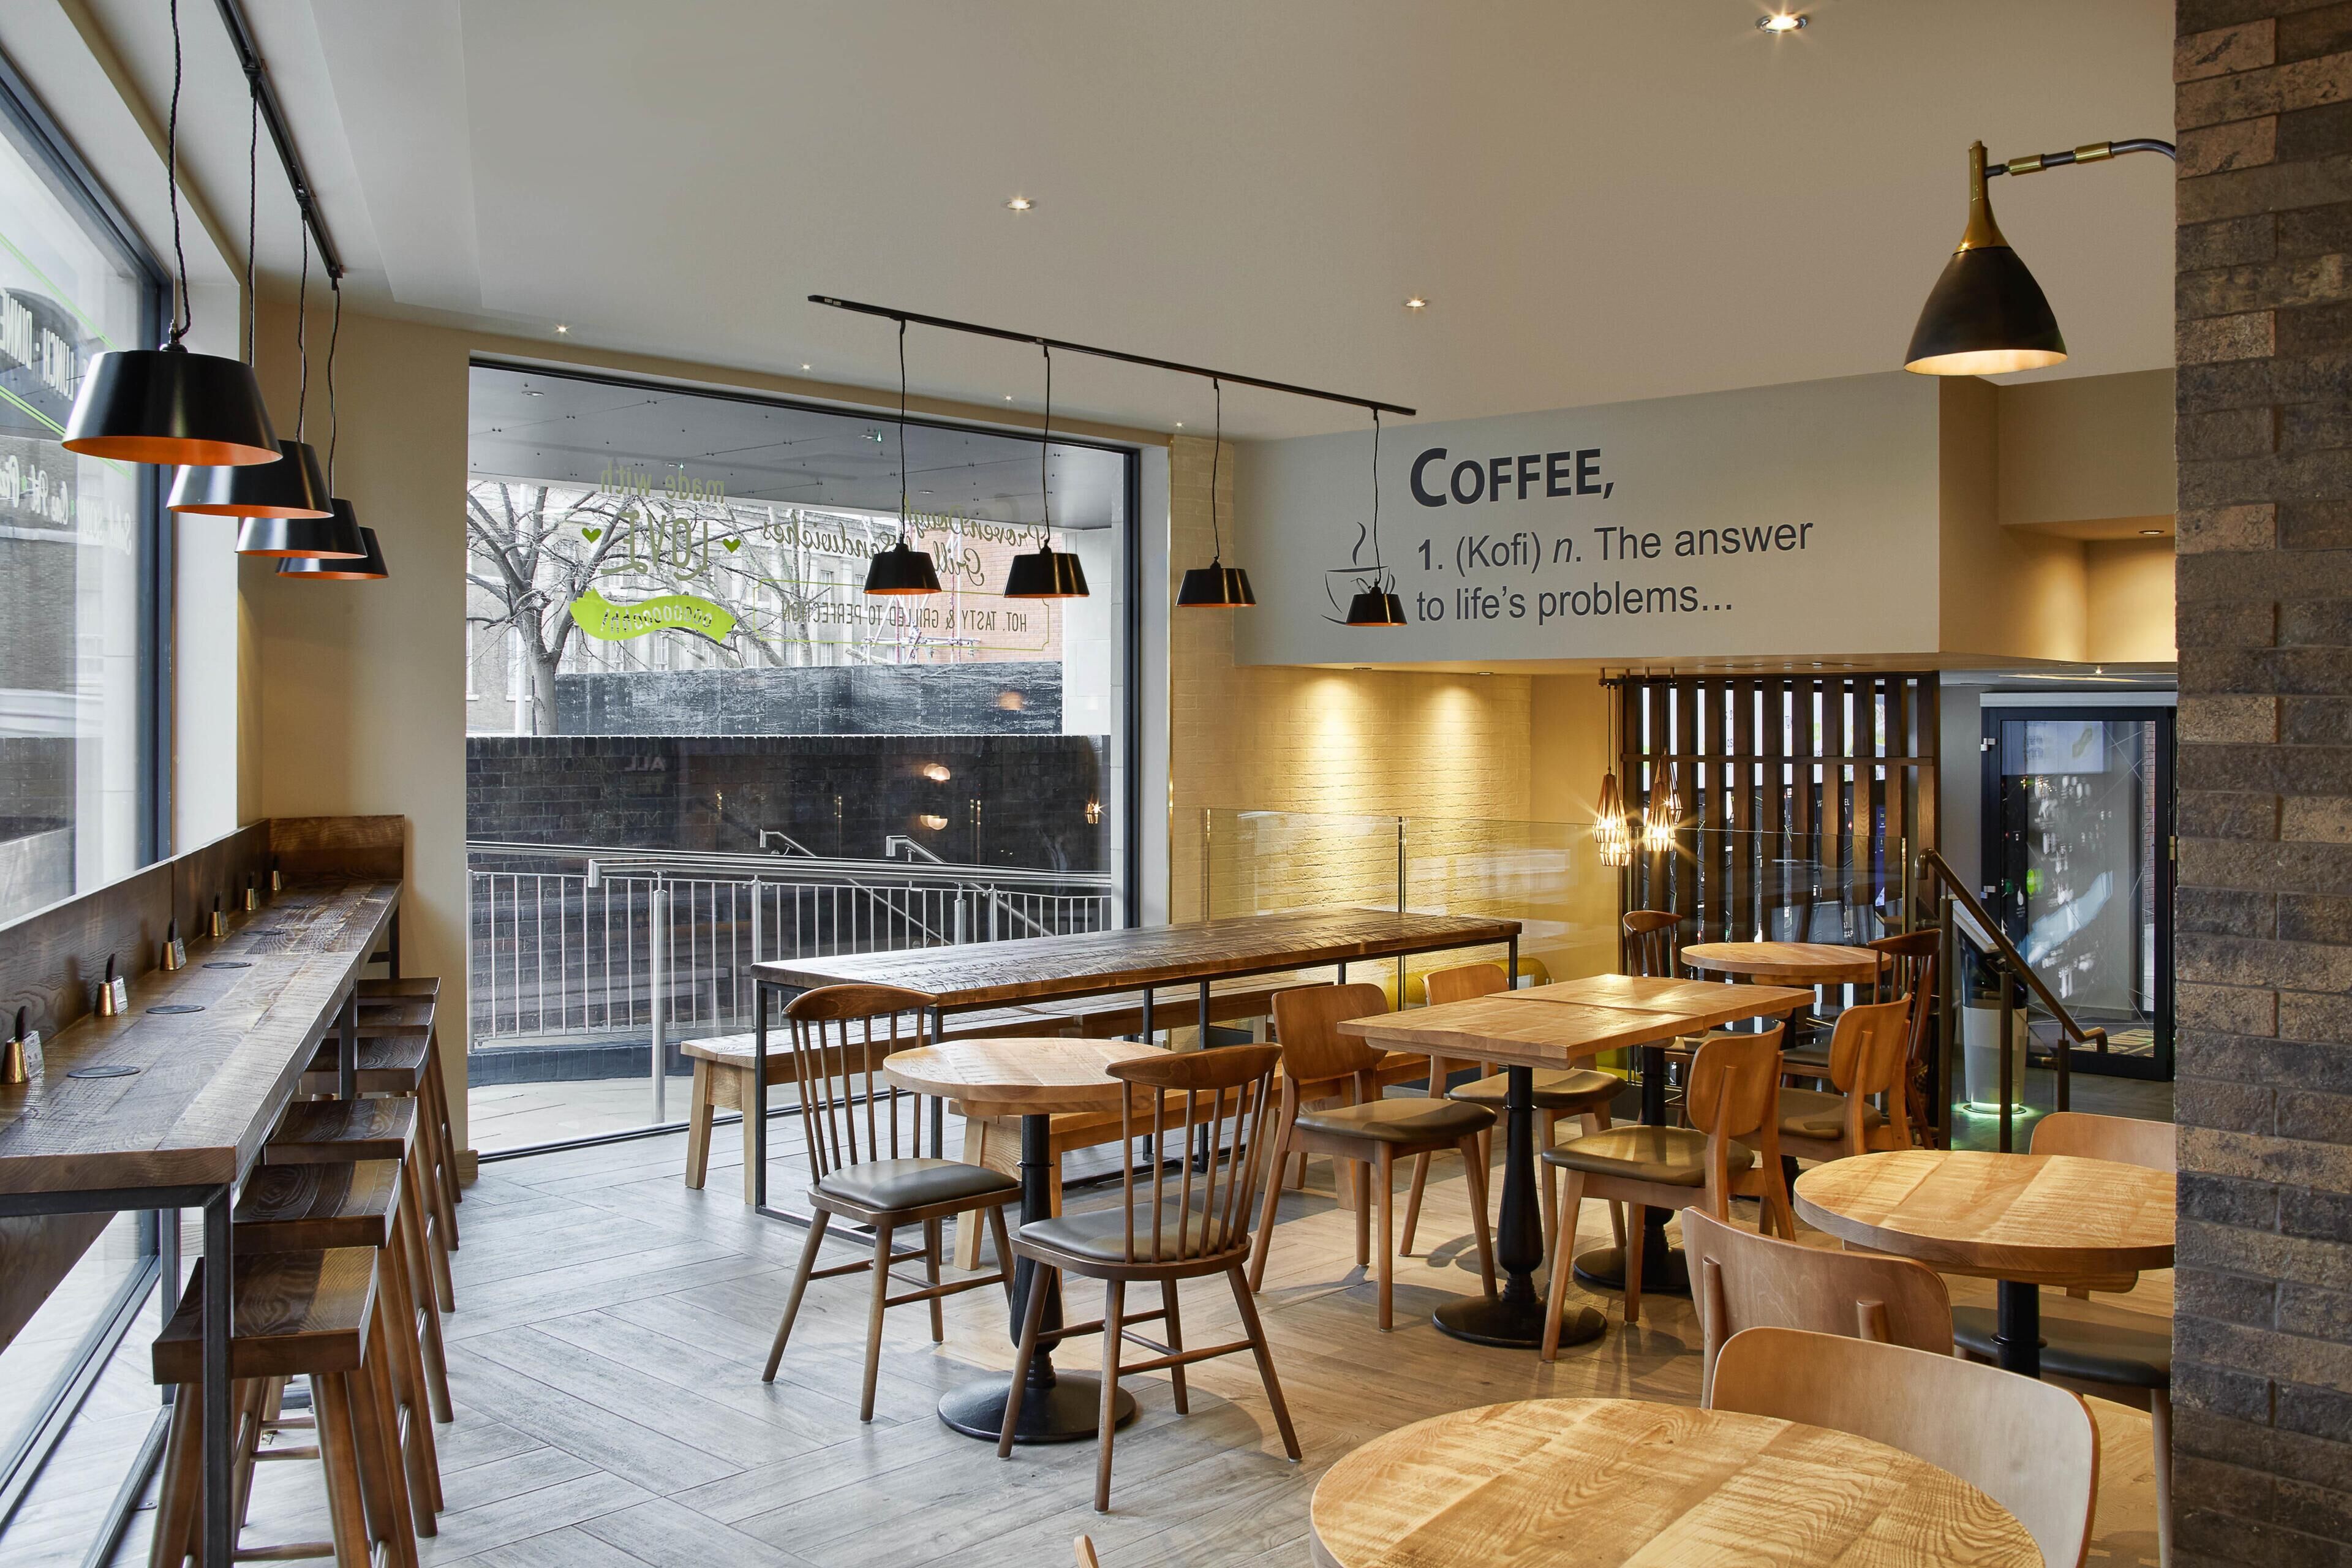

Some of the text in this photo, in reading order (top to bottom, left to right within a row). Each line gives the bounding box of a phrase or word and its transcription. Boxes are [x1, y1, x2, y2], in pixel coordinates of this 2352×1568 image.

[1417, 522, 1814, 578] 1. (Kofi) n. The answer
[1415, 590, 1444, 622] to
